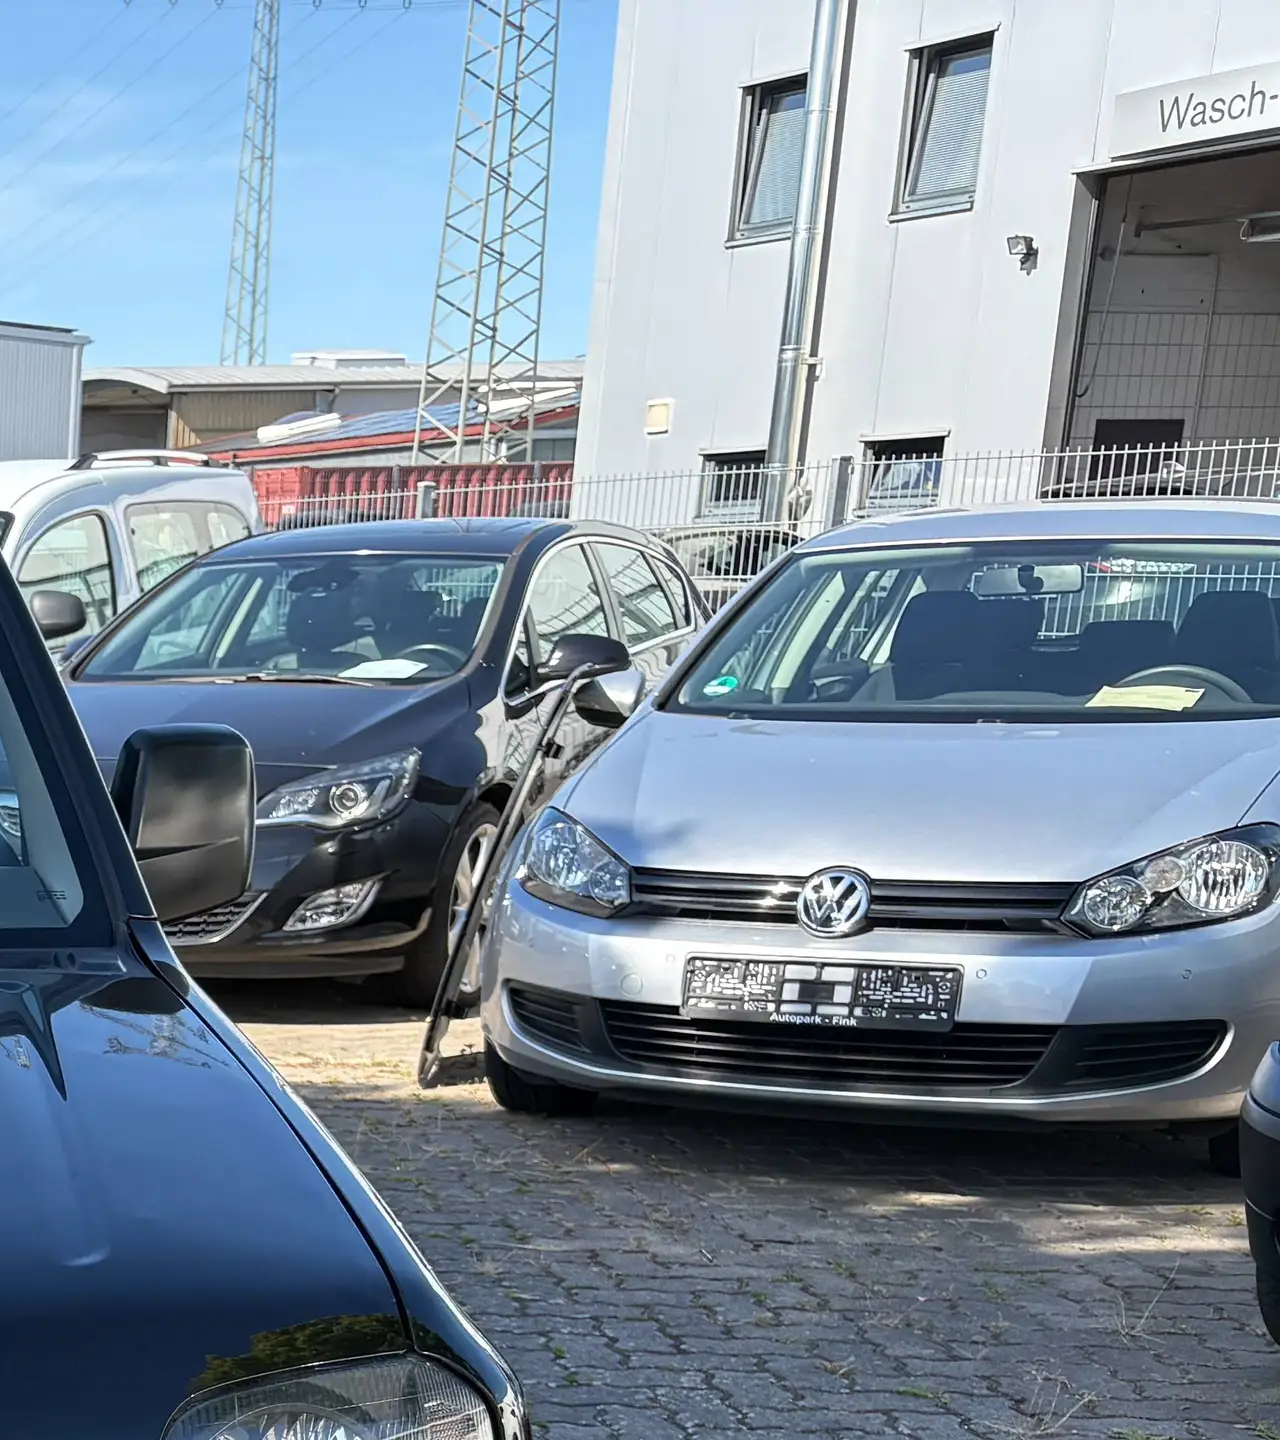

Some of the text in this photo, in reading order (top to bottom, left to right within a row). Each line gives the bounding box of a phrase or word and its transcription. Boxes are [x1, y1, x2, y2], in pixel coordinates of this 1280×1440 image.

[1159, 80, 1279, 133] Wasch-
[769, 1011, 822, 1025] Autopark
[832, 1015, 858, 1027] Fink
